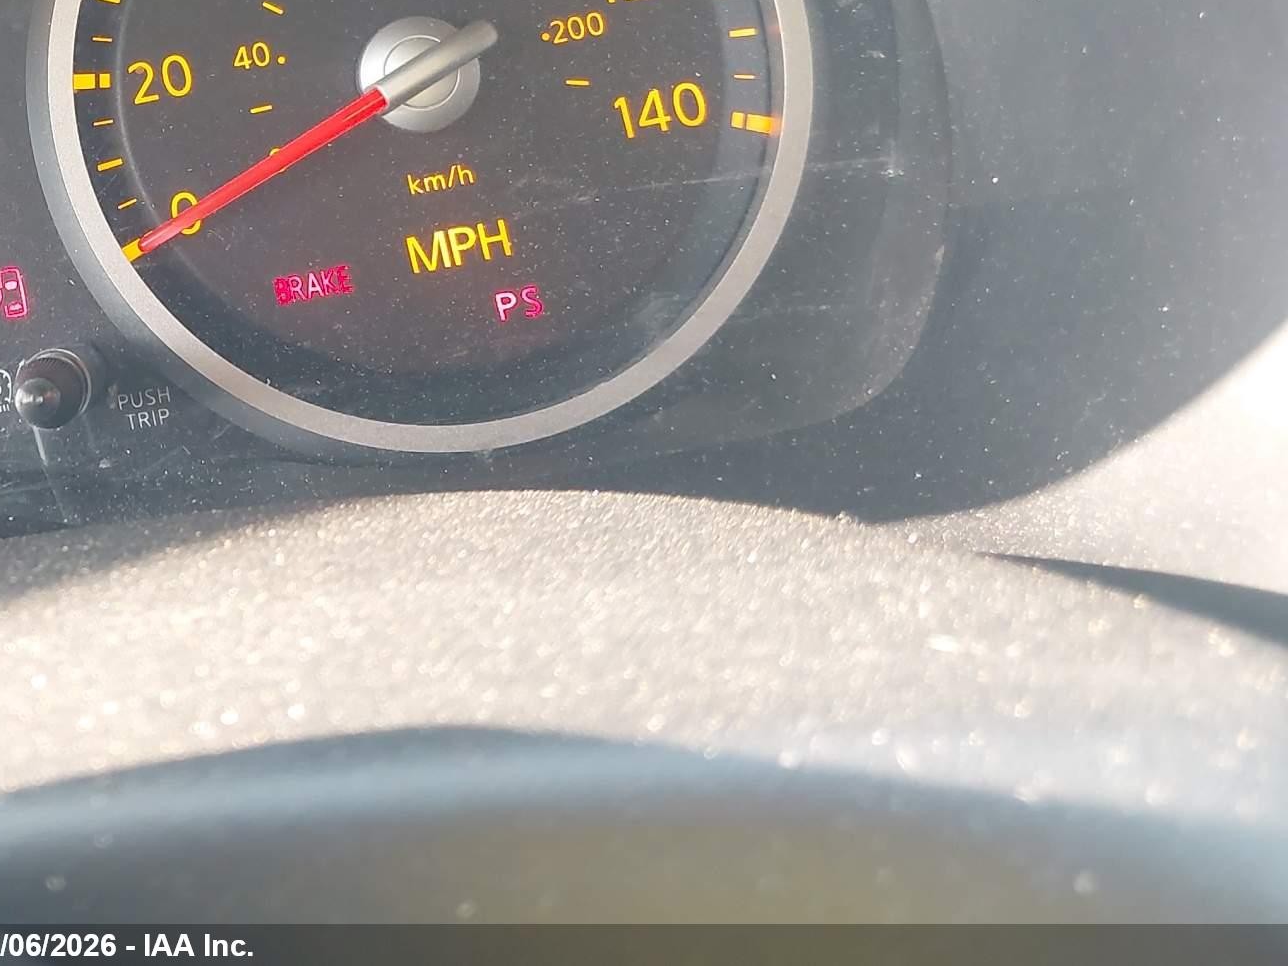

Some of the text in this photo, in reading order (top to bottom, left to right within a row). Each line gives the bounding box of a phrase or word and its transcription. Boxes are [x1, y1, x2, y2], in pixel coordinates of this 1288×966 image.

[551, 11, 605, 45] 200
[233, 42, 271, 70] 40
[128, 54, 193, 106] 20
[614, 81, 707, 139] 140
[406, 164, 475, 195] km/h
[170, 192, 203, 236] 0
[405, 219, 513, 275] MPH
[274, 265, 352, 306] BRAKE
[117, 386, 172, 412] PUSH
[124, 408, 171, 431] TRIP
